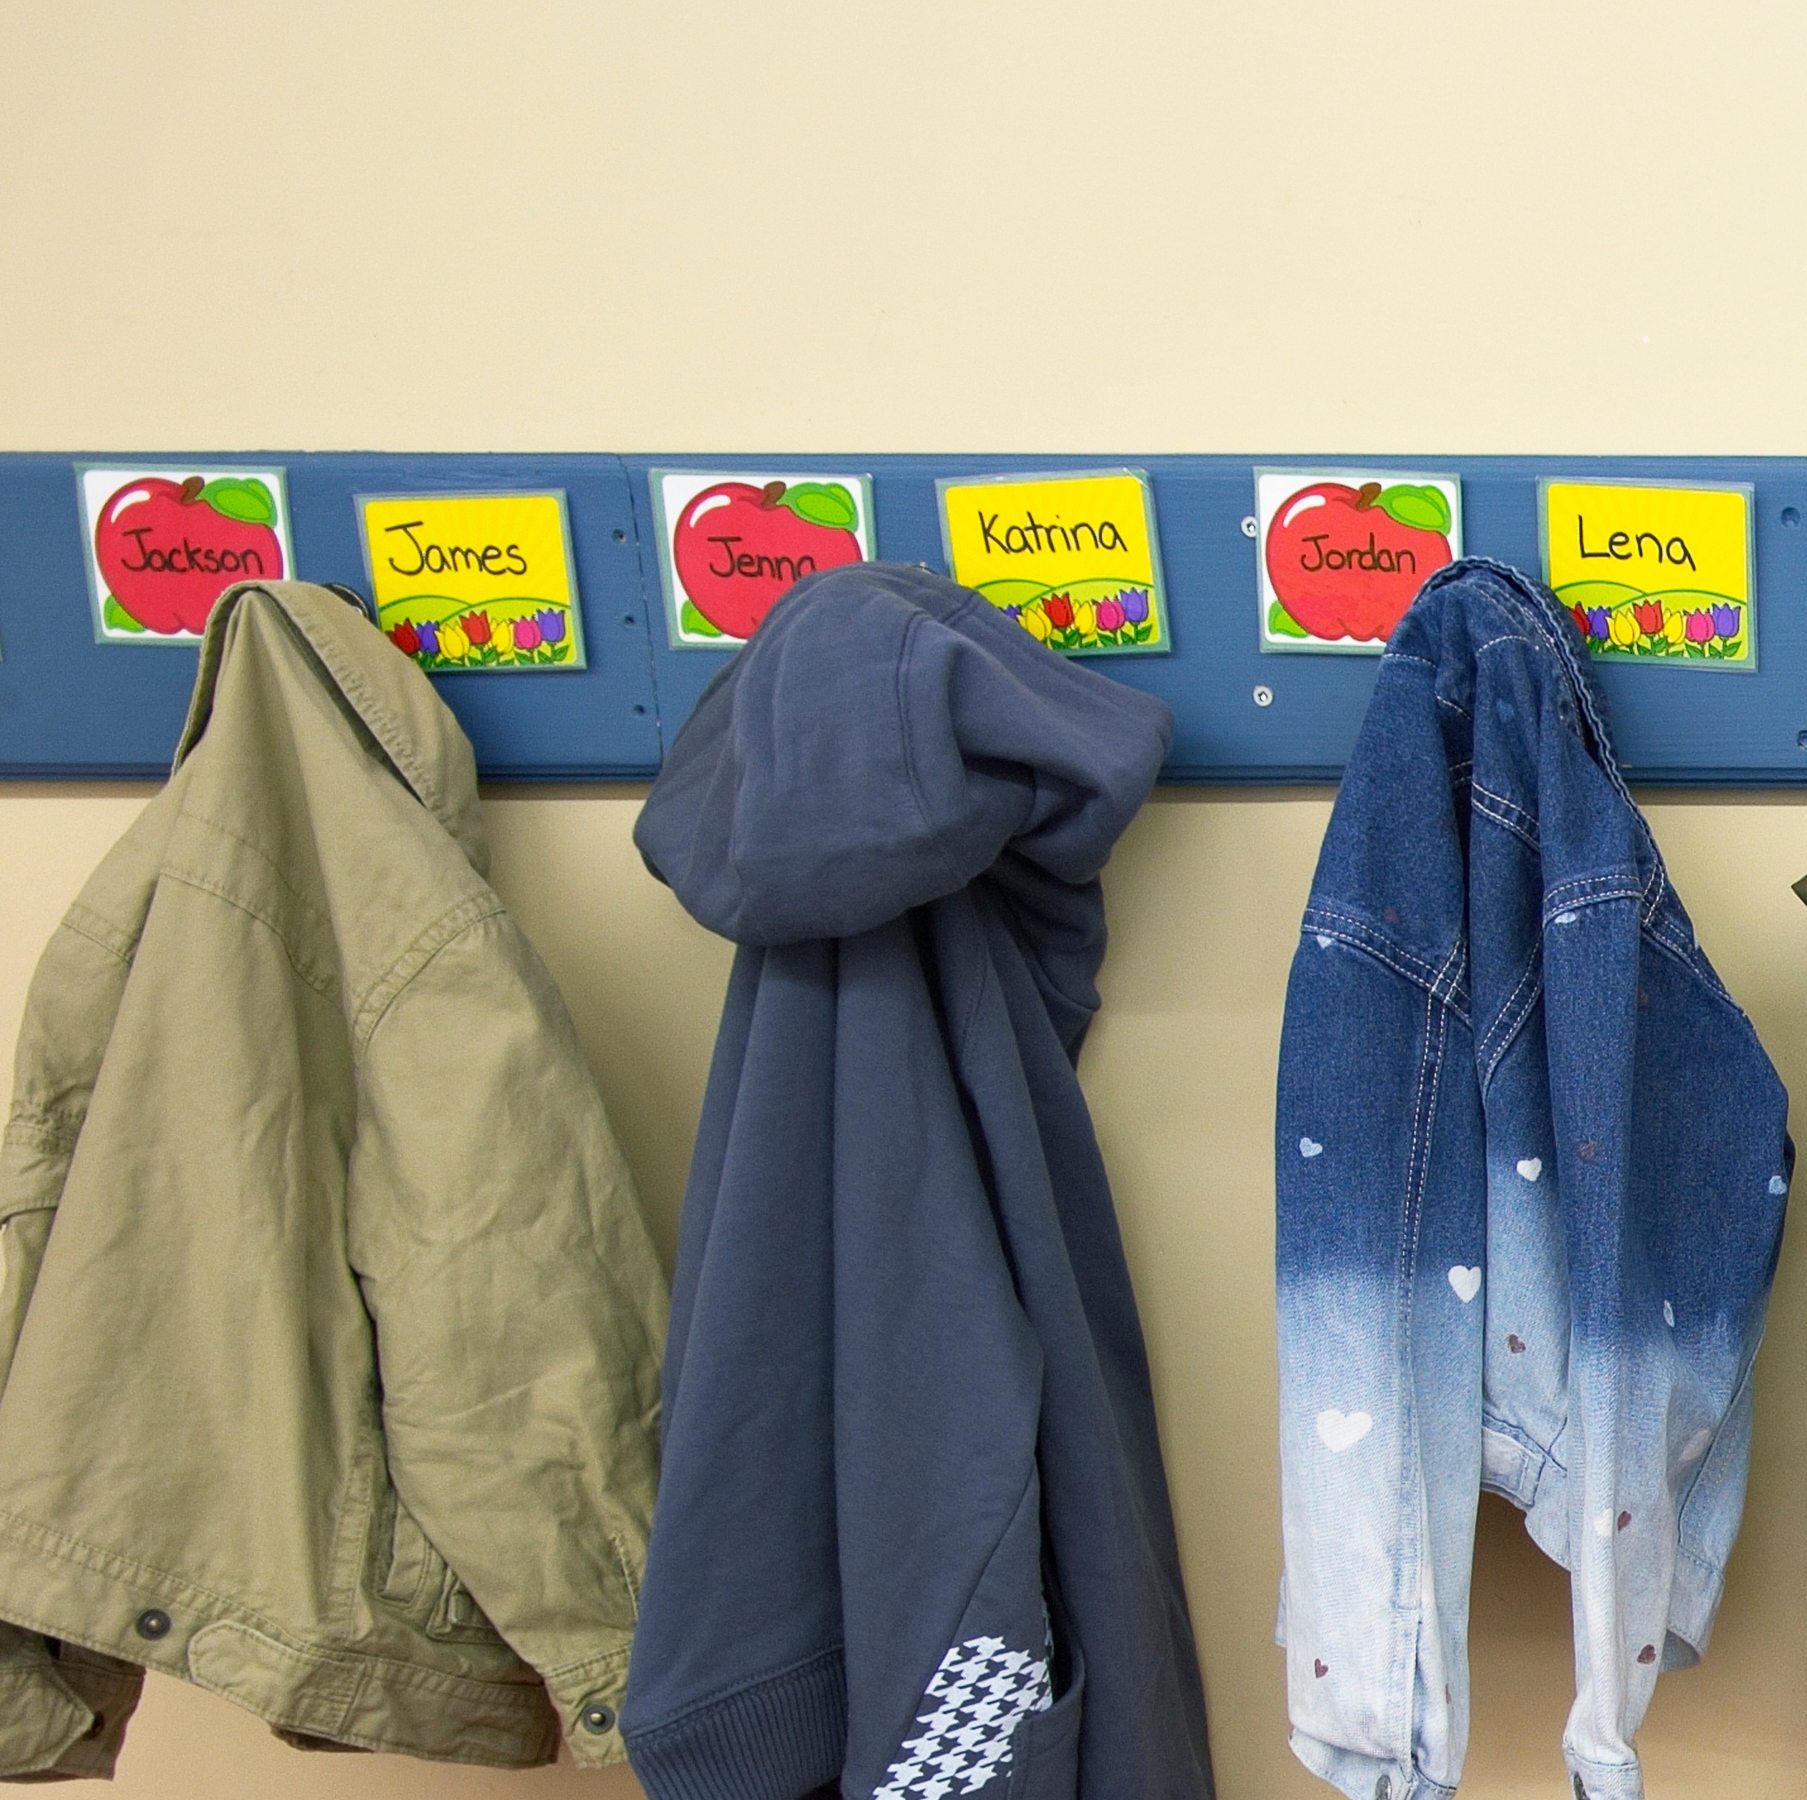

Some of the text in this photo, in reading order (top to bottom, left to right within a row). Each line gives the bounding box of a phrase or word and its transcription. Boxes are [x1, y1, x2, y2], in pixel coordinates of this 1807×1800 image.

[122, 528, 265, 574] Jackson
[385, 521, 528, 577] James
[978, 511, 1127, 555] Katrina
[1299, 533, 1416, 574] Jordan
[1578, 516, 1696, 571] Lena
[708, 536, 815, 580] Jenna
